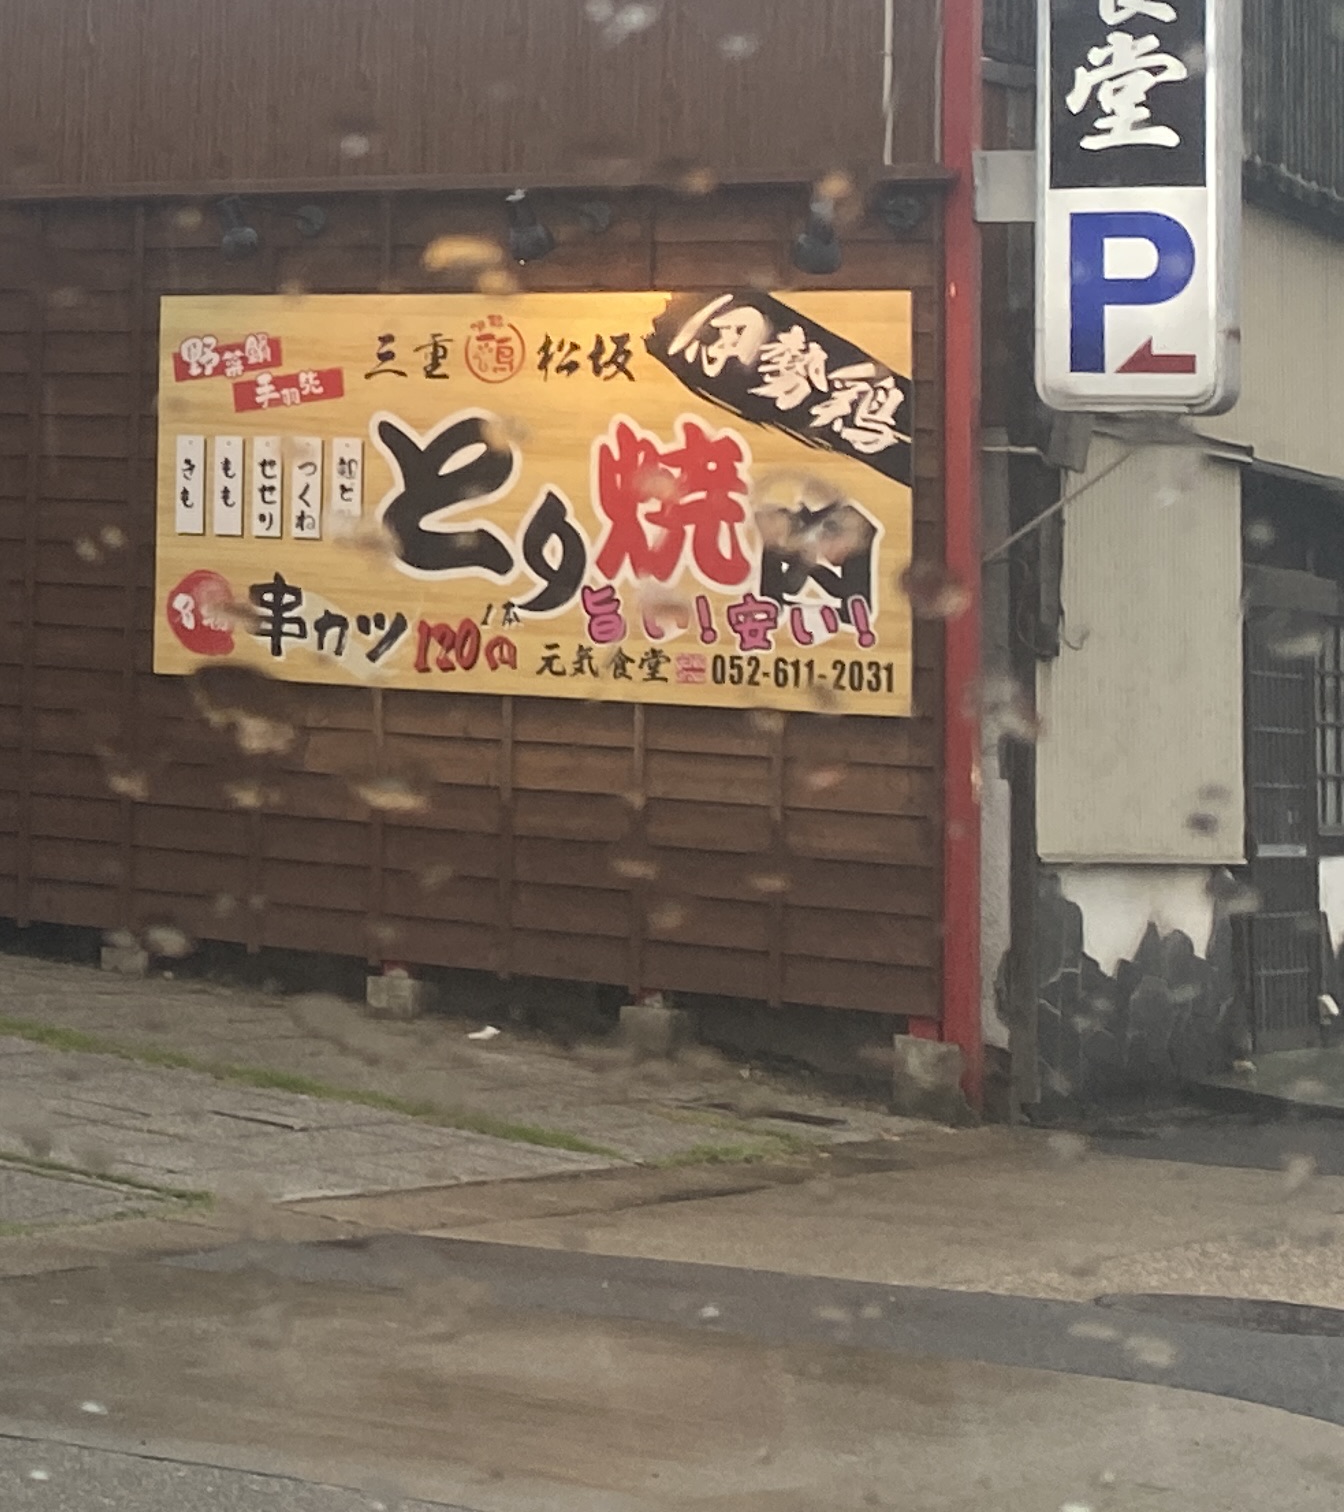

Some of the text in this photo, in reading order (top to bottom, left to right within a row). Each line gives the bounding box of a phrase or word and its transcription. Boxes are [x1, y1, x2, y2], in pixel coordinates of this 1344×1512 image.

[1069, 211, 1196, 373] P
[364, 334, 453, 380] 三重
[180, 457, 196, 509] きも
[220, 456, 237, 509] もも
[257, 457, 278, 532] せせり
[294, 460, 318, 532] つくね
[247, 571, 409, 663] 串カツ
[535, 643, 671, 683] 元気食堂
[712, 654, 894, 693] 052-611-2031
